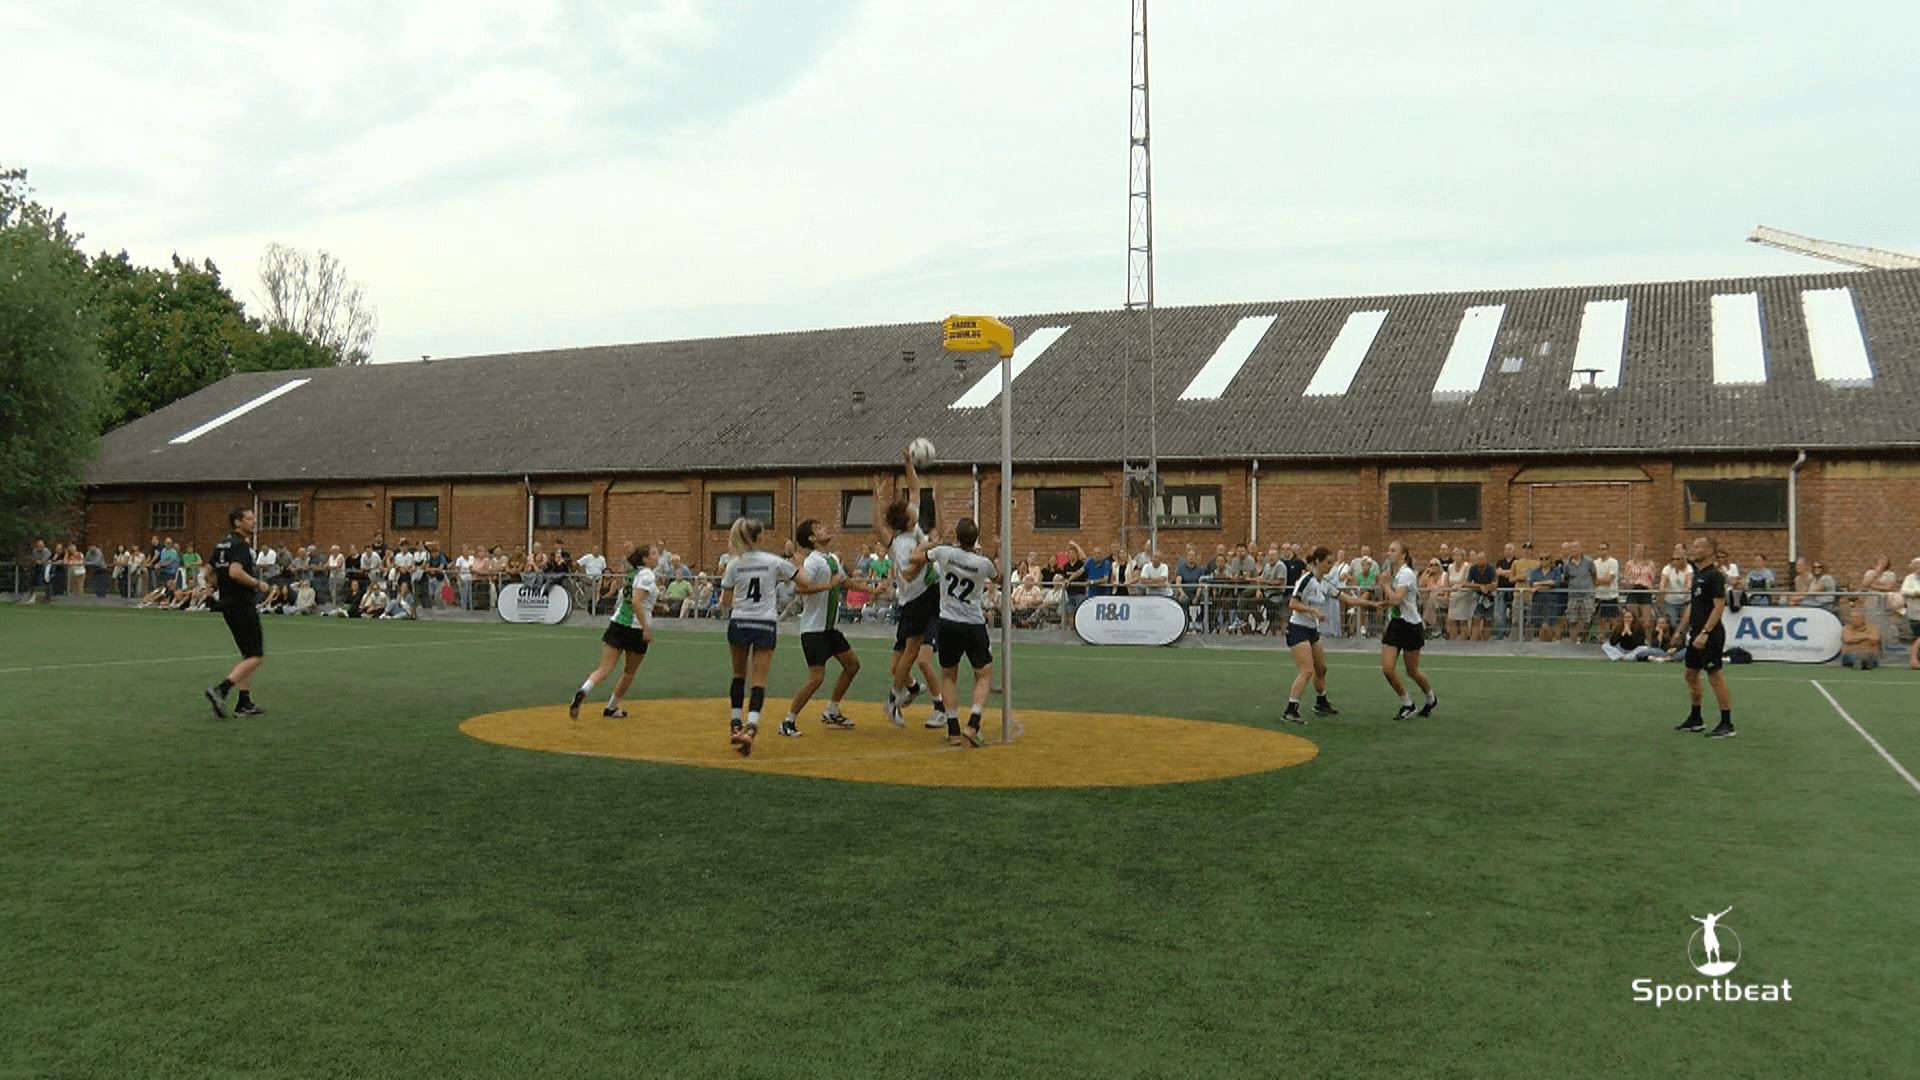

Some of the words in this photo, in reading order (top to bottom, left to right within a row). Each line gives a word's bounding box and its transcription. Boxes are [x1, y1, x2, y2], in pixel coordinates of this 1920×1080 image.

[746, 577, 762, 603] 4
[945, 572, 975, 605] 22
[1095, 603, 1131, 621] R&O
[1734, 616, 1809, 641] AGC
